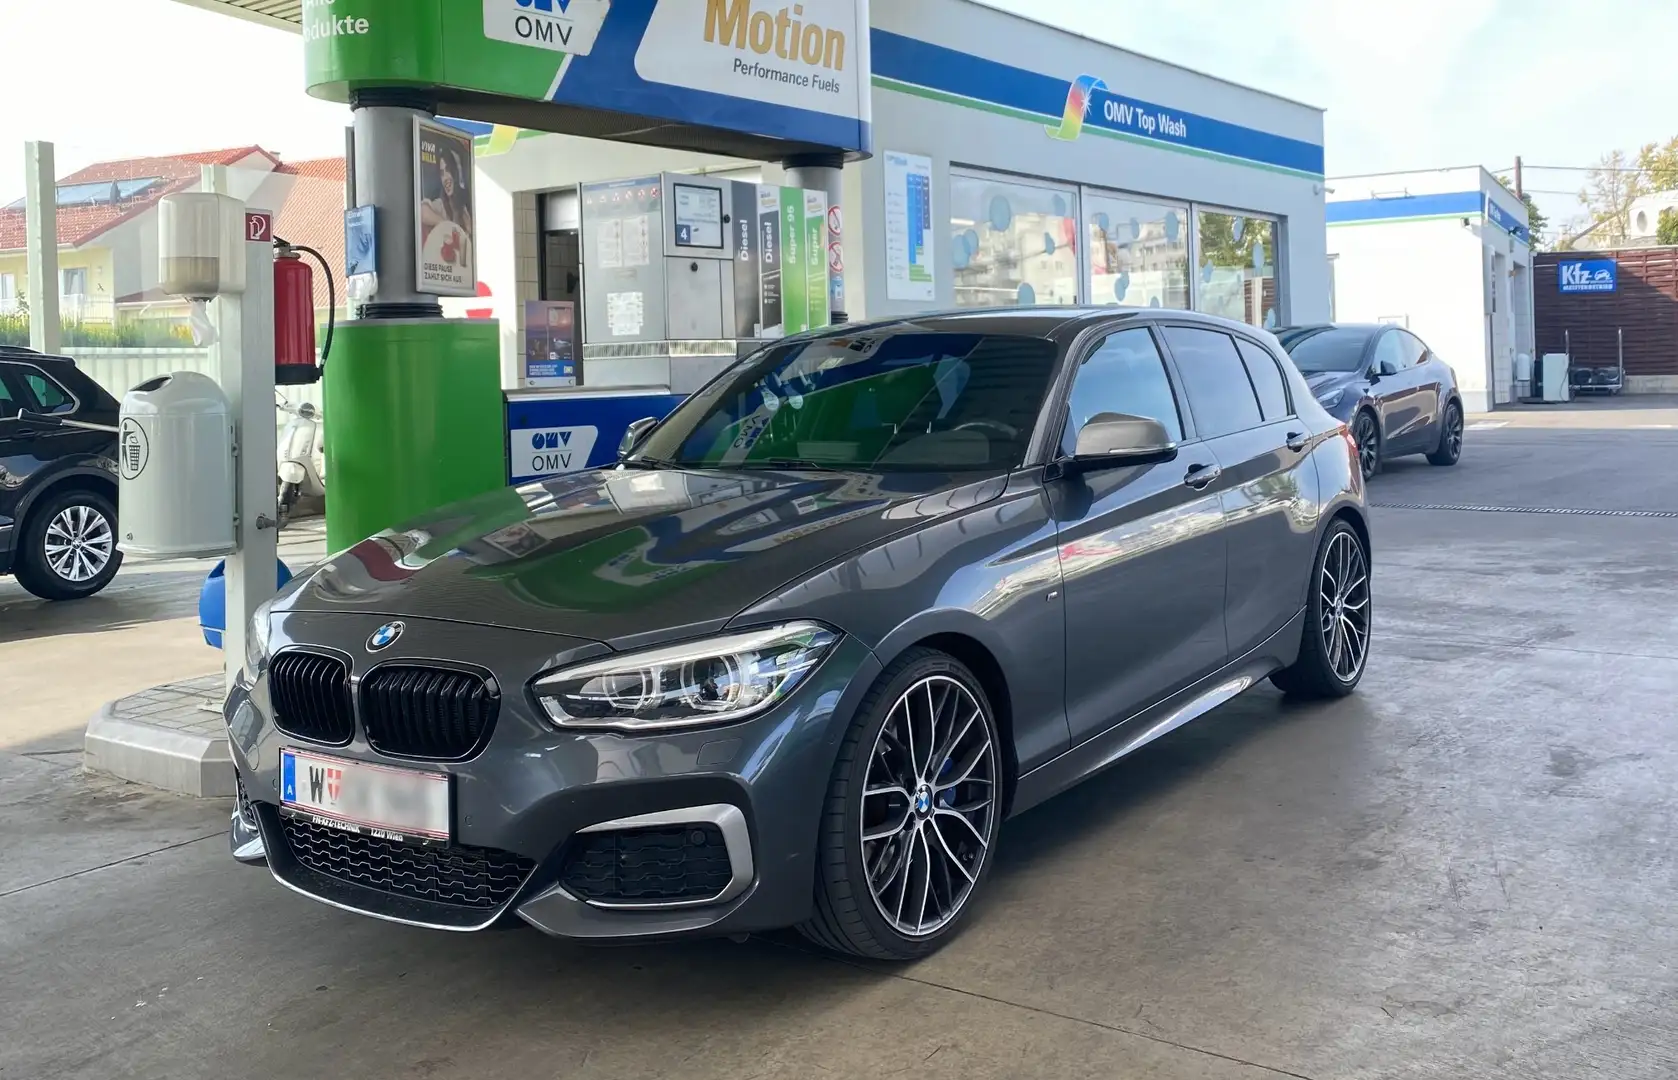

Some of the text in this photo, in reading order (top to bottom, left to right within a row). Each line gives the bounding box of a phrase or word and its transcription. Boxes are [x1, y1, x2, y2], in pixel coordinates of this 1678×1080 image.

[515, 15, 573, 46] OMV
[704, 0, 845, 71] Motion
[734, 58, 840, 93] Performance Fuels
[1103, 99, 1187, 138] OMV Top Wash
[680, 227, 688, 240] 4
[740, 219, 749, 261] Diesel
[764, 221, 773, 263] Diesel
[788, 224, 797, 264] Super
[1562, 263, 1592, 285] Kfz
[532, 453, 572, 471] OMV
[287, 784, 293, 795] A
[309, 765, 325, 804] W
